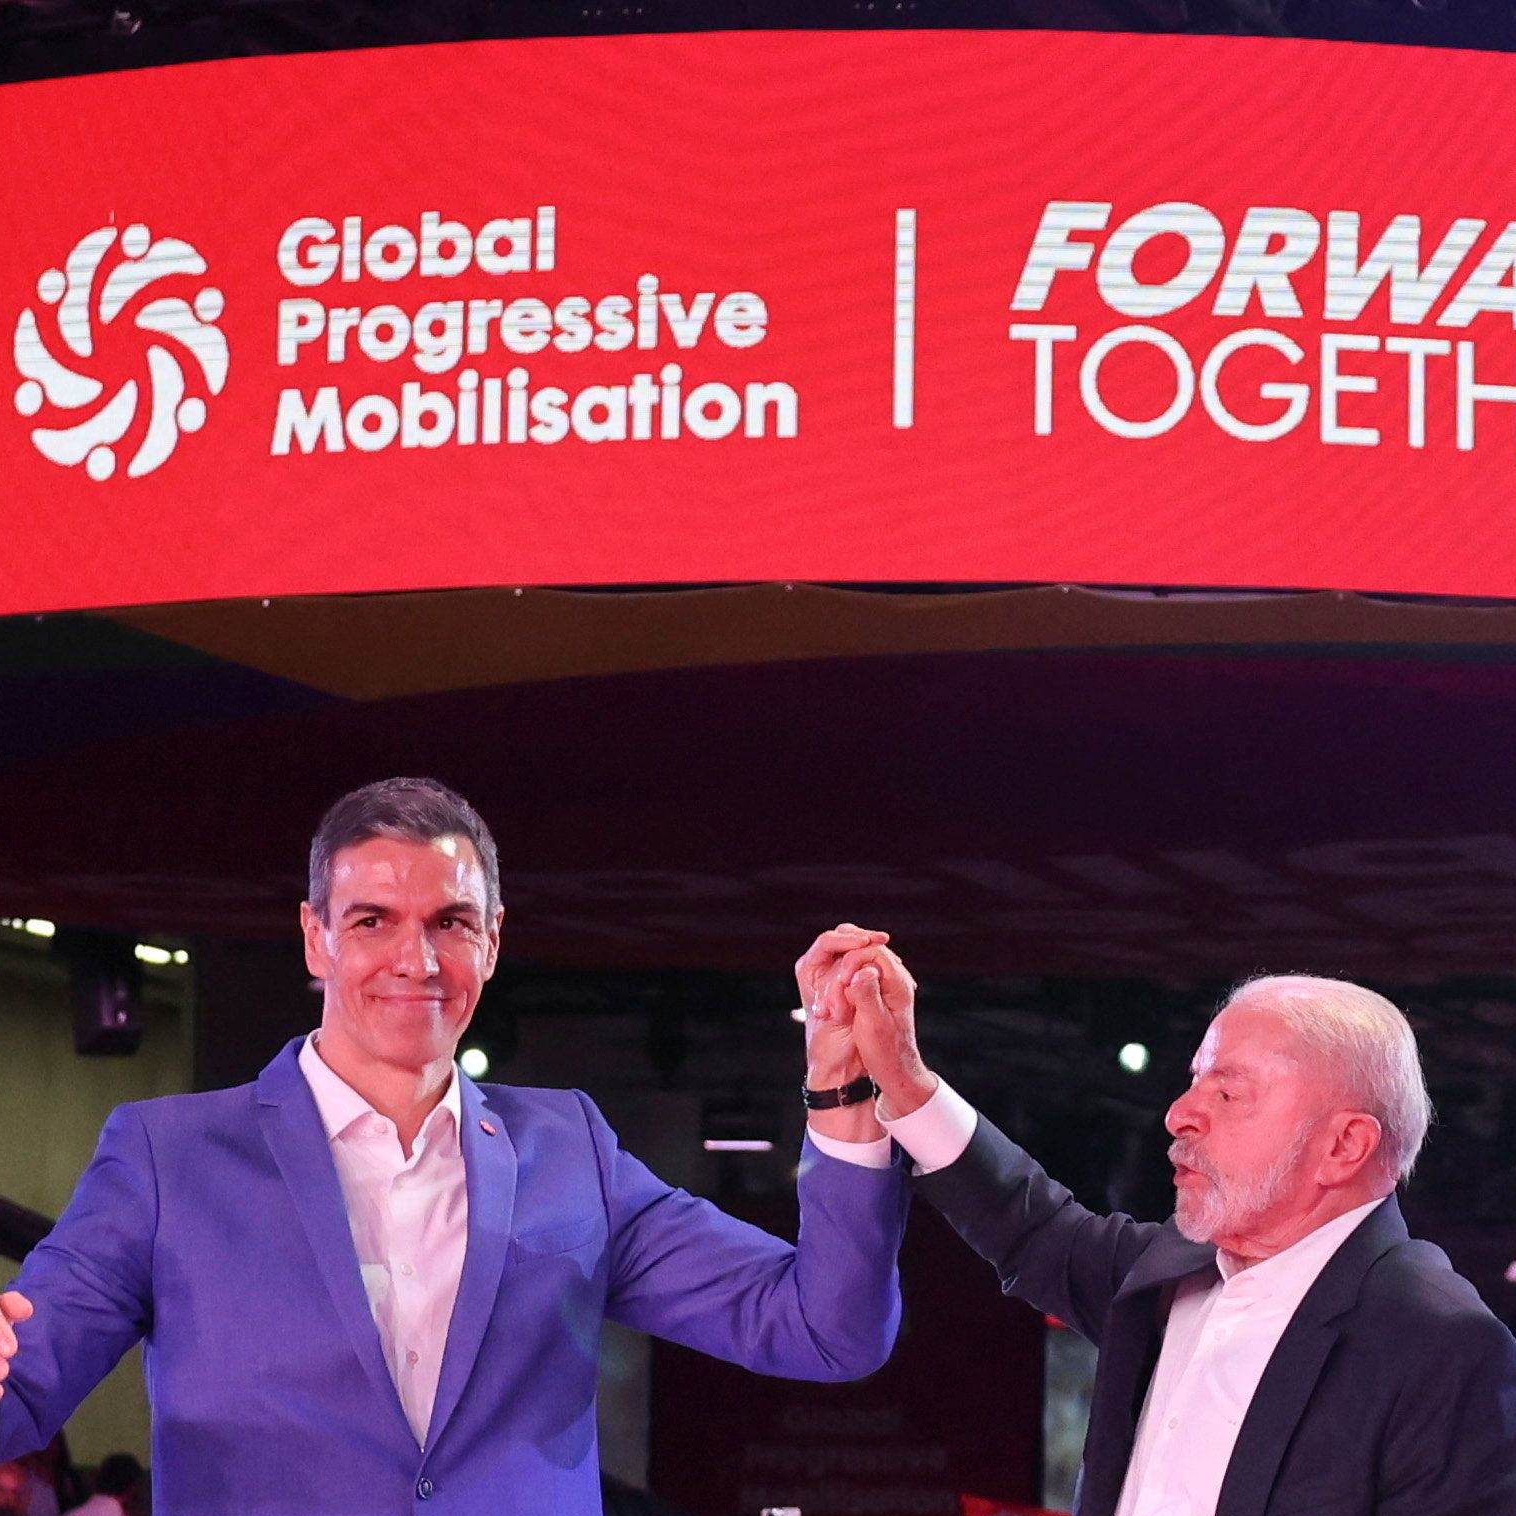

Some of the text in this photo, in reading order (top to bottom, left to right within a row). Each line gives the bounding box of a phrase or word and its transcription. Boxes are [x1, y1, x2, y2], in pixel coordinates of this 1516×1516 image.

[277, 206, 555, 287] Global
[277, 273, 768, 375] Progressive
[271, 363, 799, 456] Mobilisation
